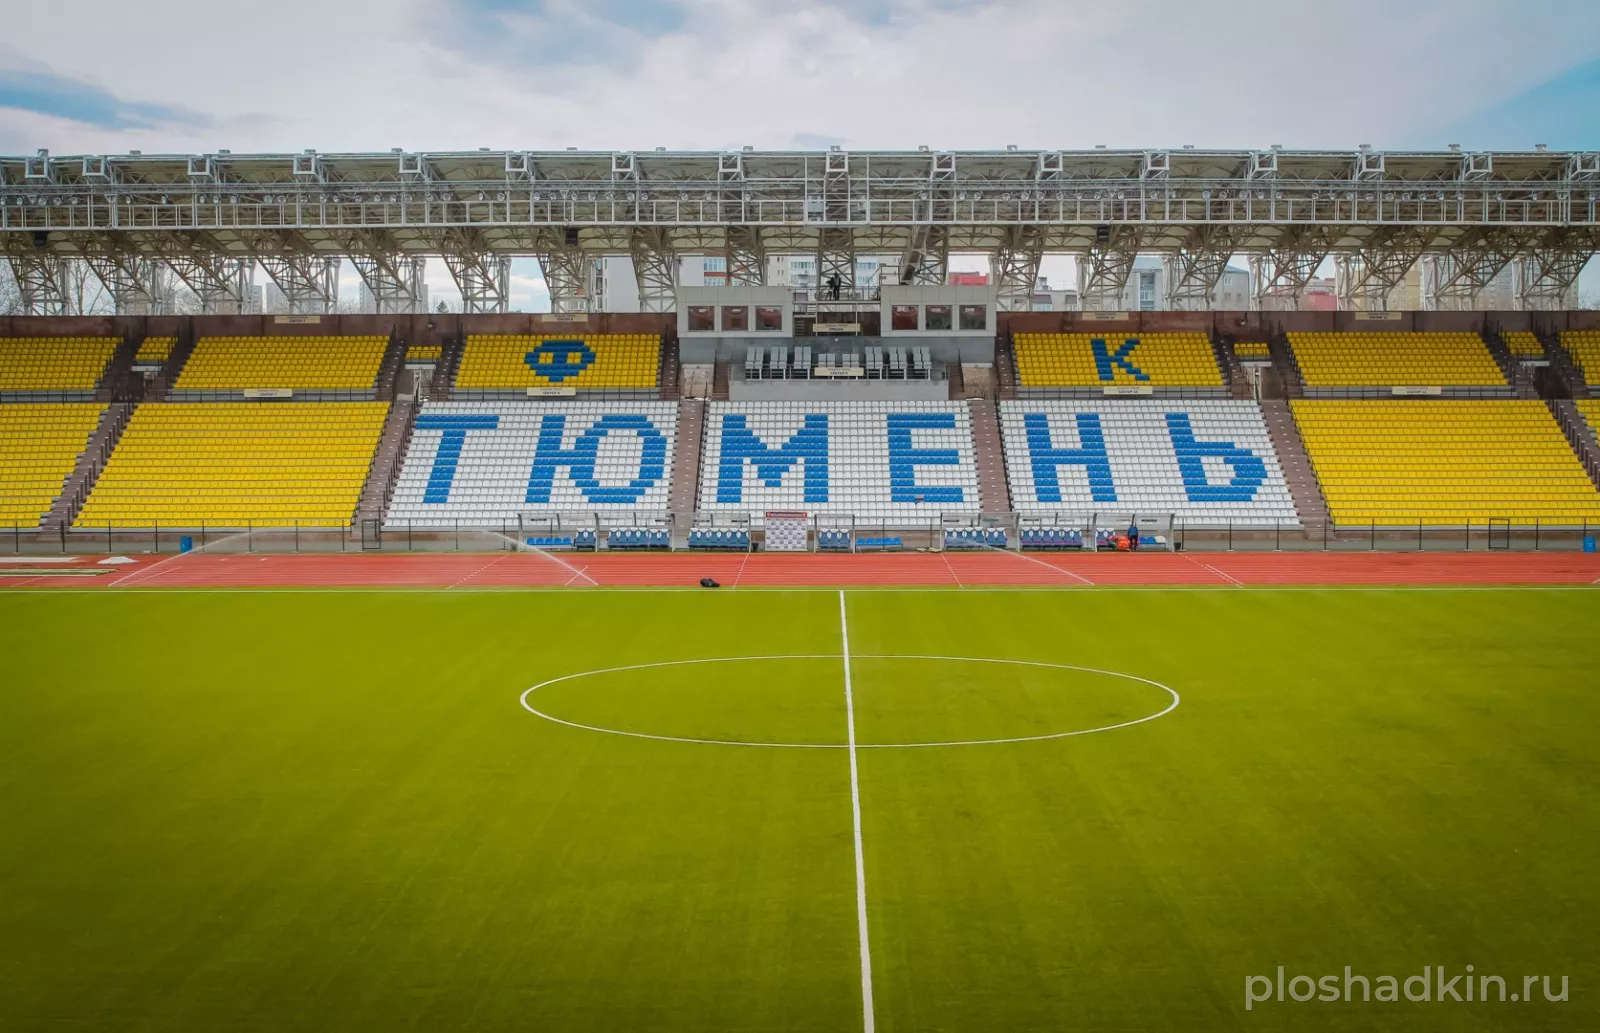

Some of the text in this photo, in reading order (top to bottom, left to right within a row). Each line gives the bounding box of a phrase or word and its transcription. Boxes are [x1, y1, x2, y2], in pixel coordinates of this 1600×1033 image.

[524, 339, 1150, 382] Ф К
[415, 413, 1268, 503] ТЮМЕНЬ
